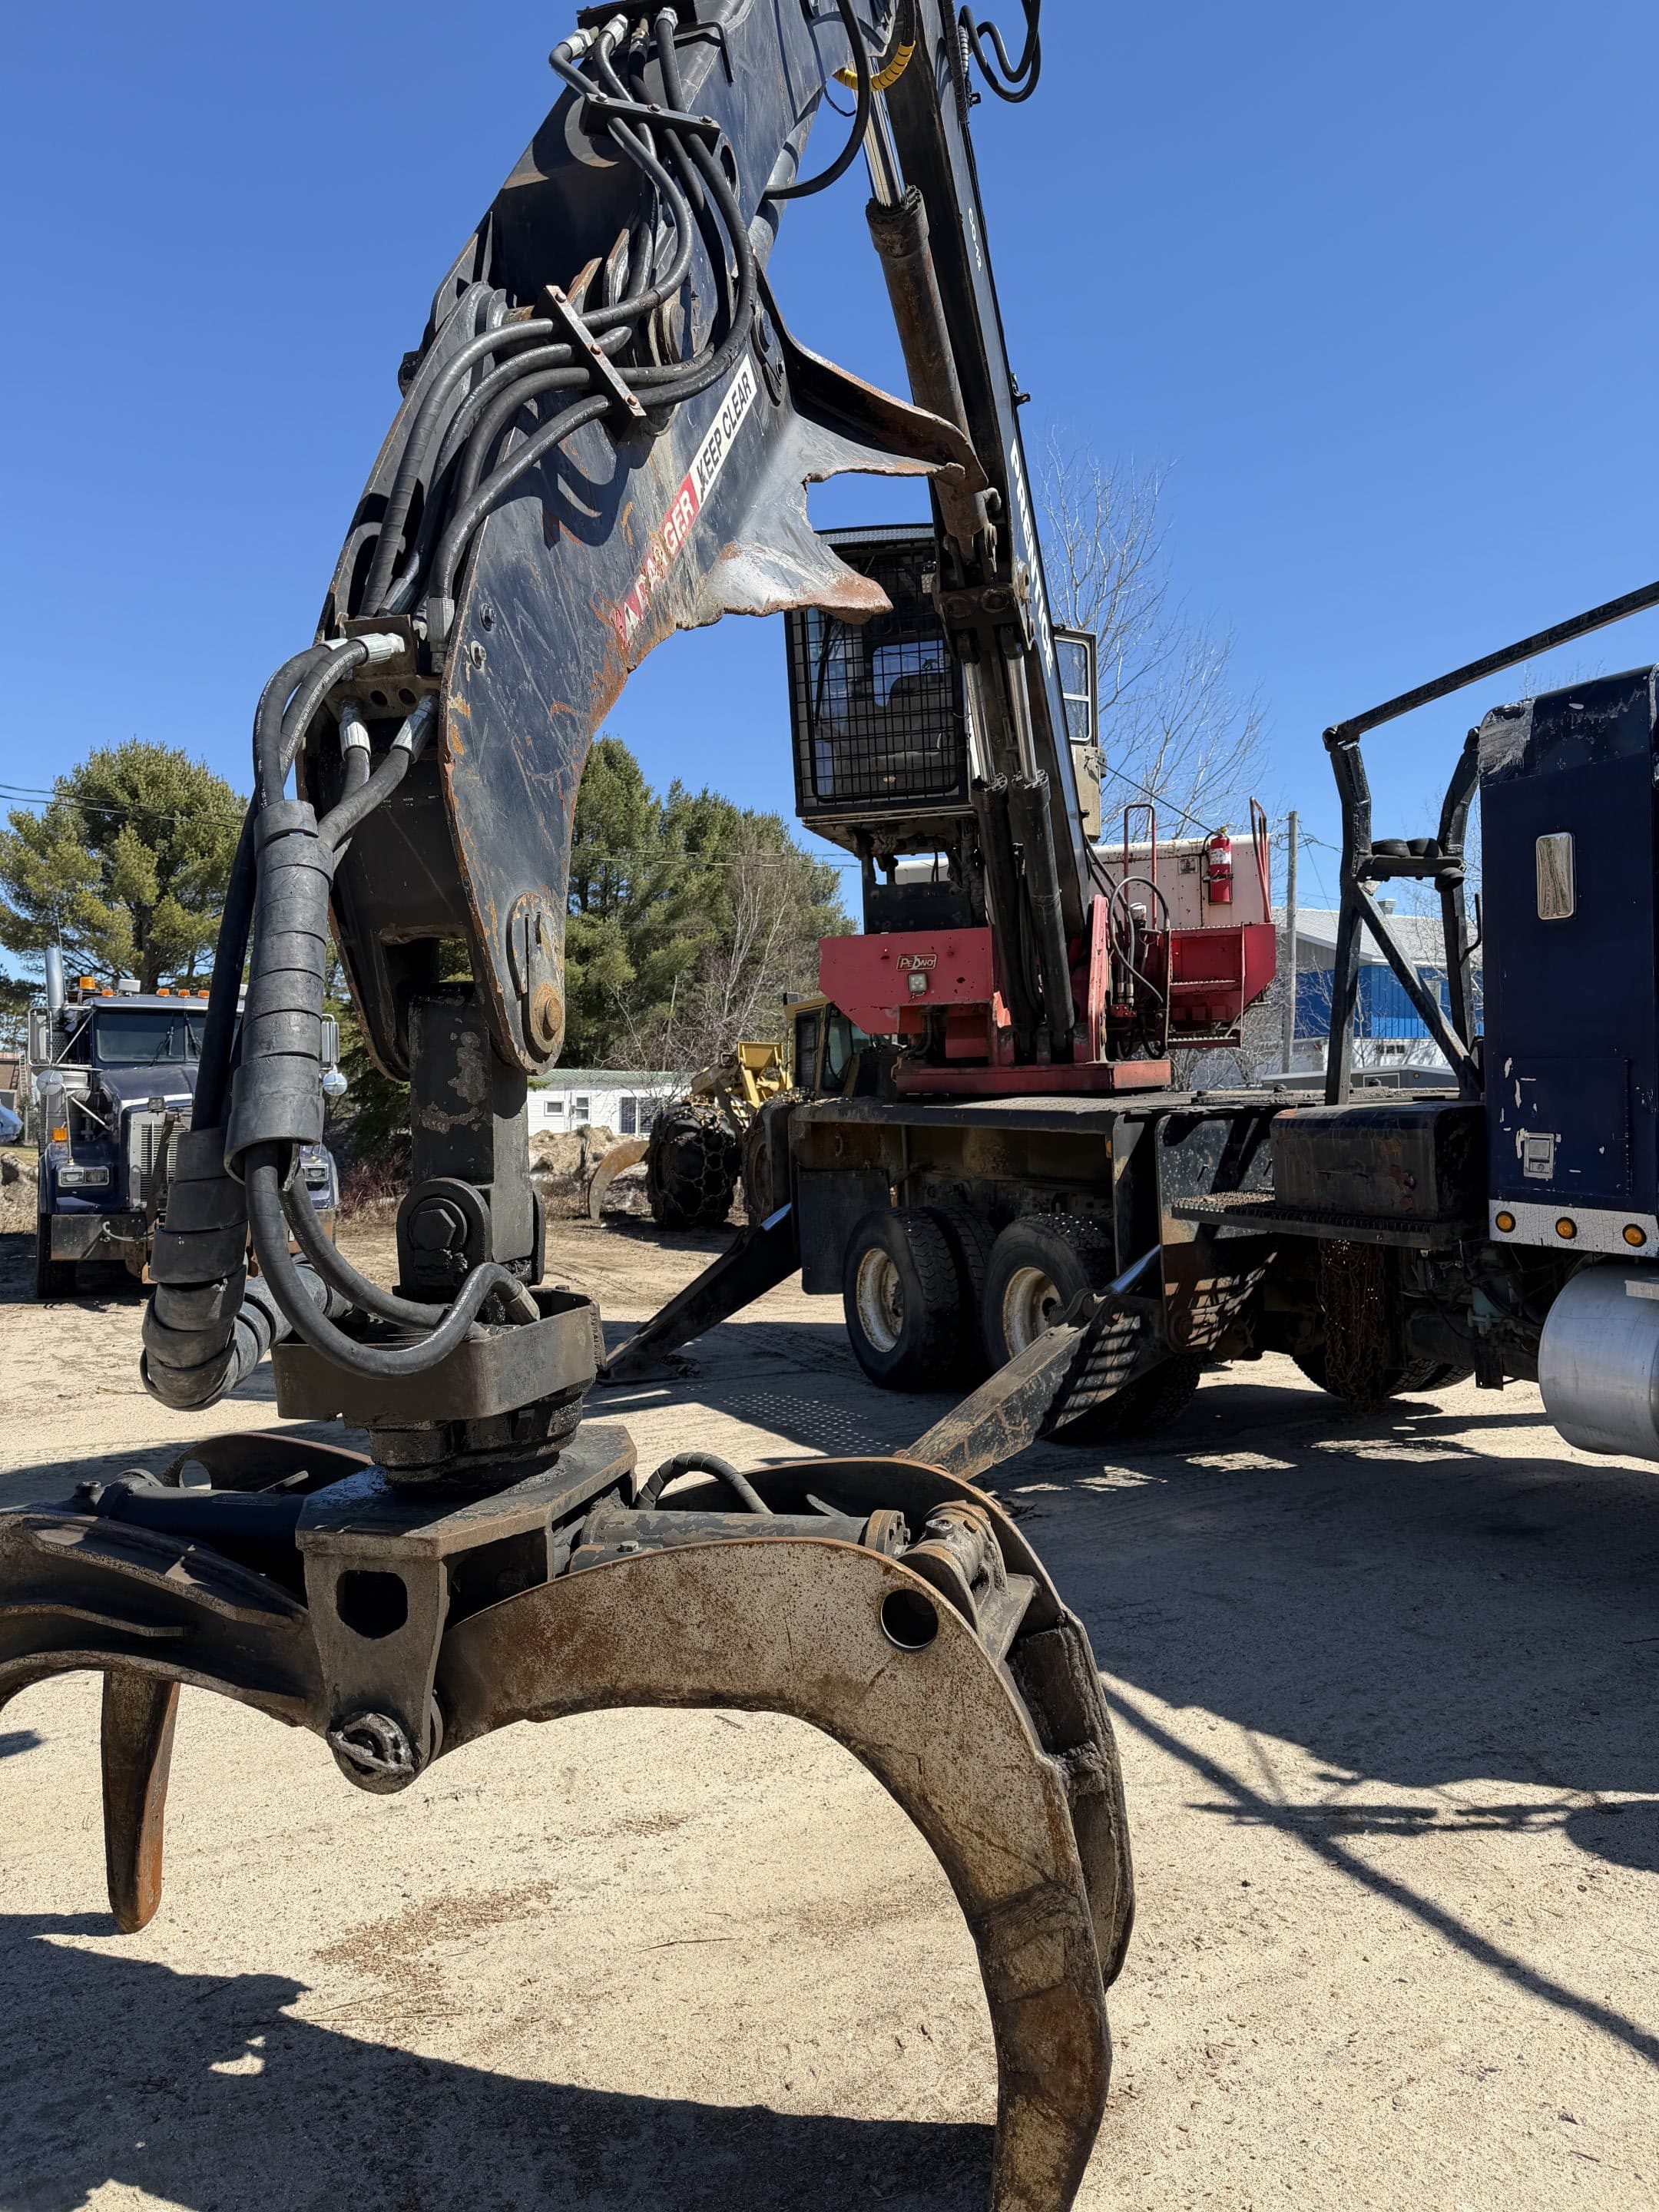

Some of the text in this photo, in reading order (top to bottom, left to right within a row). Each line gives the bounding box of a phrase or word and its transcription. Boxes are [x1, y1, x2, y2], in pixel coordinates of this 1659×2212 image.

[696, 429, 724, 492] KEEP
[722, 373, 752, 439] CLEAR
[1010, 438, 1053, 678] PRENTICE
